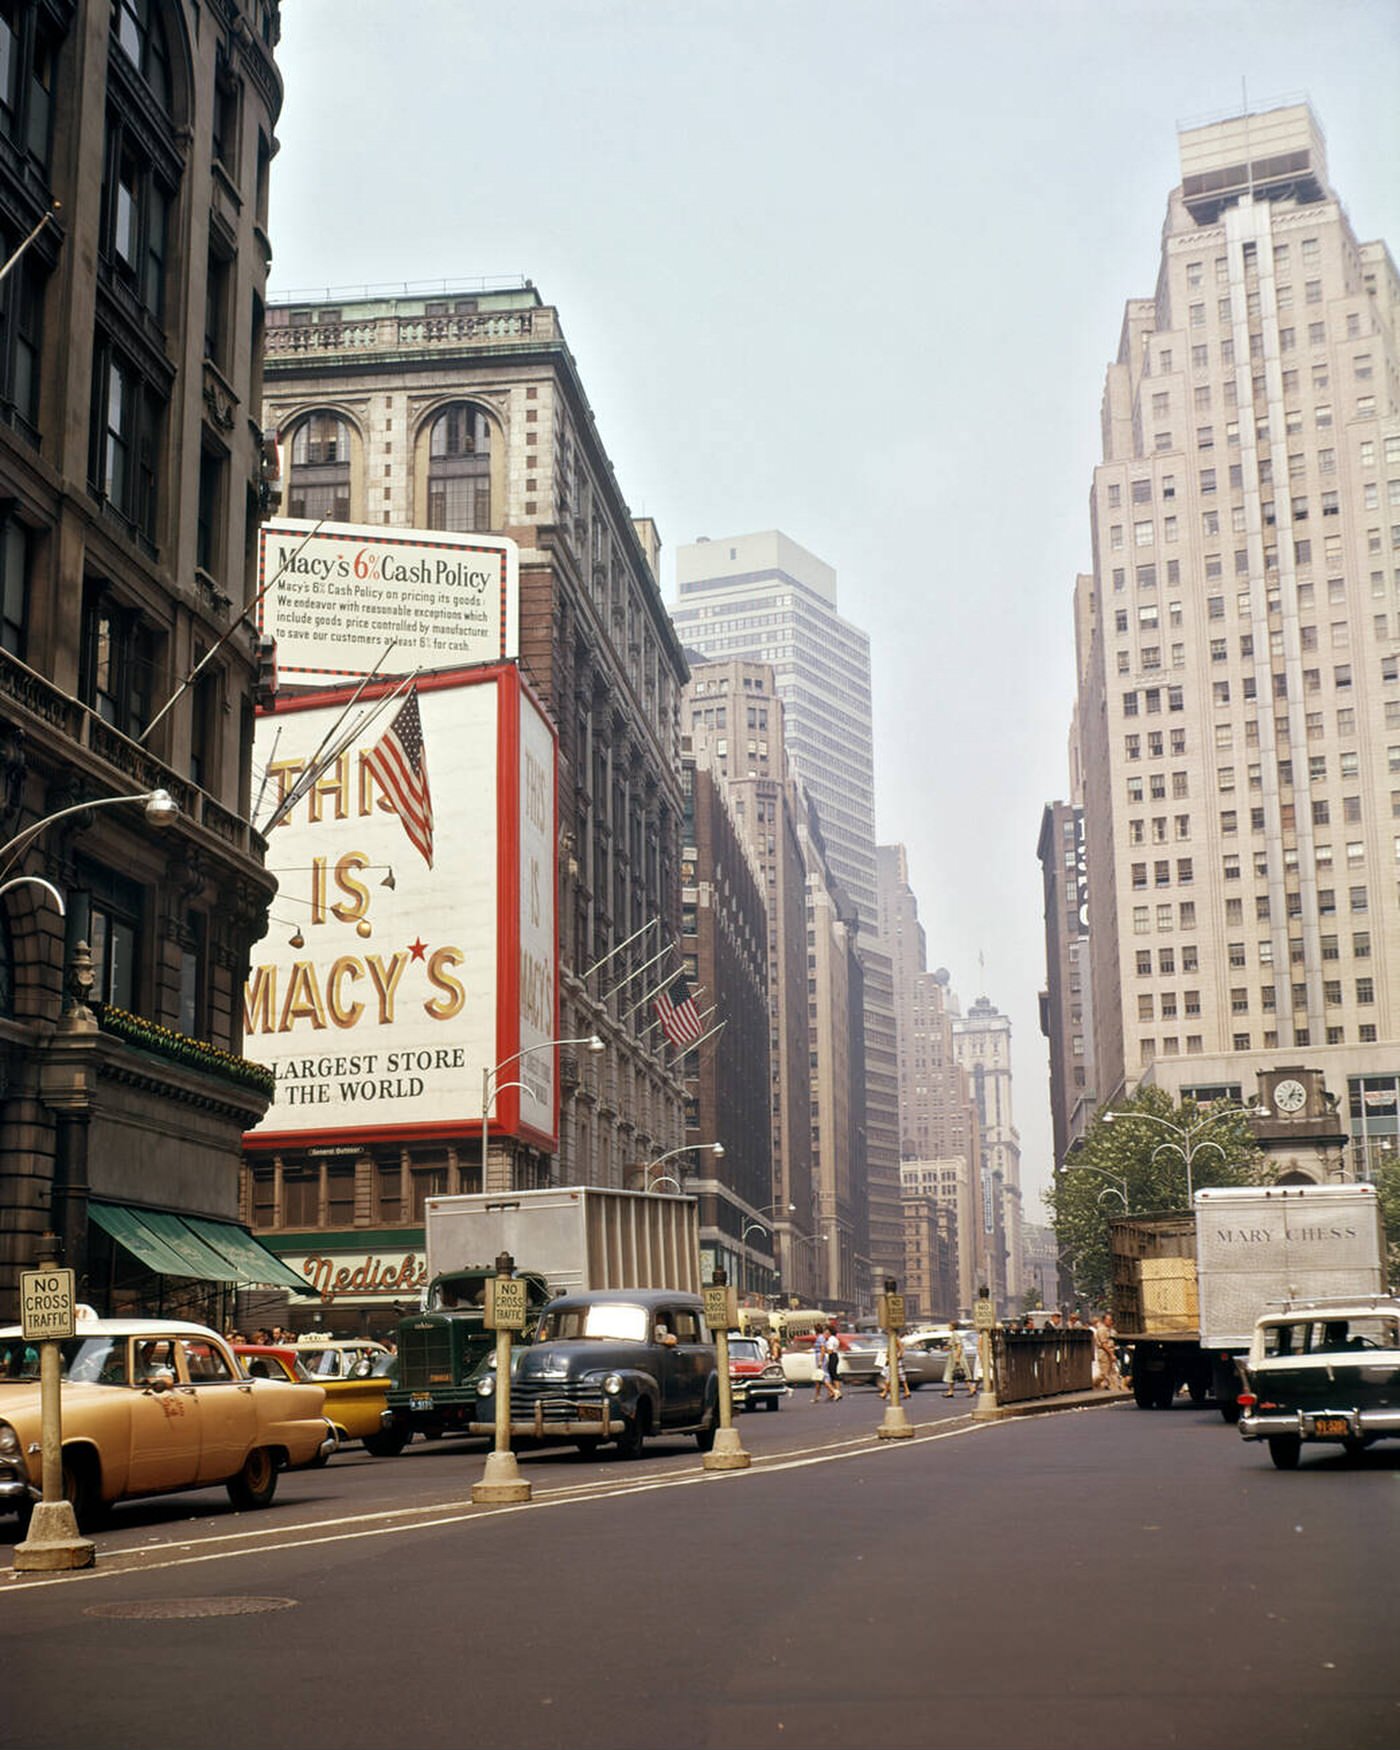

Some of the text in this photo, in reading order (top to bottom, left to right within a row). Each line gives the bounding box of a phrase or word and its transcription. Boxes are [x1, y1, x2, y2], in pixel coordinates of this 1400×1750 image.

[278, 547, 491, 593] Macy's 6% Cash Policy
[277, 579, 311, 594] Macy's
[313, 582, 326, 594] 6%
[328, 583, 353, 597] Cash
[354, 584, 383, 600] Policy
[386, 591, 399, 600] on
[401, 588, 435, 605] pricing
[438, 591, 450, 604] its
[277, 595, 488, 622] We endeavor with reasonable exceptions which
[277, 611, 312, 624] include
[314, 615, 342, 627] goods
[346, 616, 369, 629] price
[371, 618, 417, 632] controlled
[419, 621, 430, 635] by
[276, 627, 286, 638] to
[288, 628, 309, 639] save
[313, 631, 328, 641] our
[331, 632, 381, 645] customers
[395, 636, 416, 647] least
[433, 637, 446, 649] for
[312, 851, 371, 925] IS
[271, 1049, 465, 1081] LARGEST STORE
[285, 1078, 424, 1105] THE WORLD
[1217, 1227, 1357, 1243] MARY CHESS
[34, 1278, 59, 1293] NO
[304, 1252, 428, 1304] Nedick's
[501, 1284, 518, 1295] NO
[710, 1292, 722, 1301] NO
[26, 1294, 69, 1311] CROSS
[496, 1297, 523, 1308] CROSS
[28, 1312, 69, 1328] TRAFFIC
[496, 1309, 522, 1320] TRAFFIC
